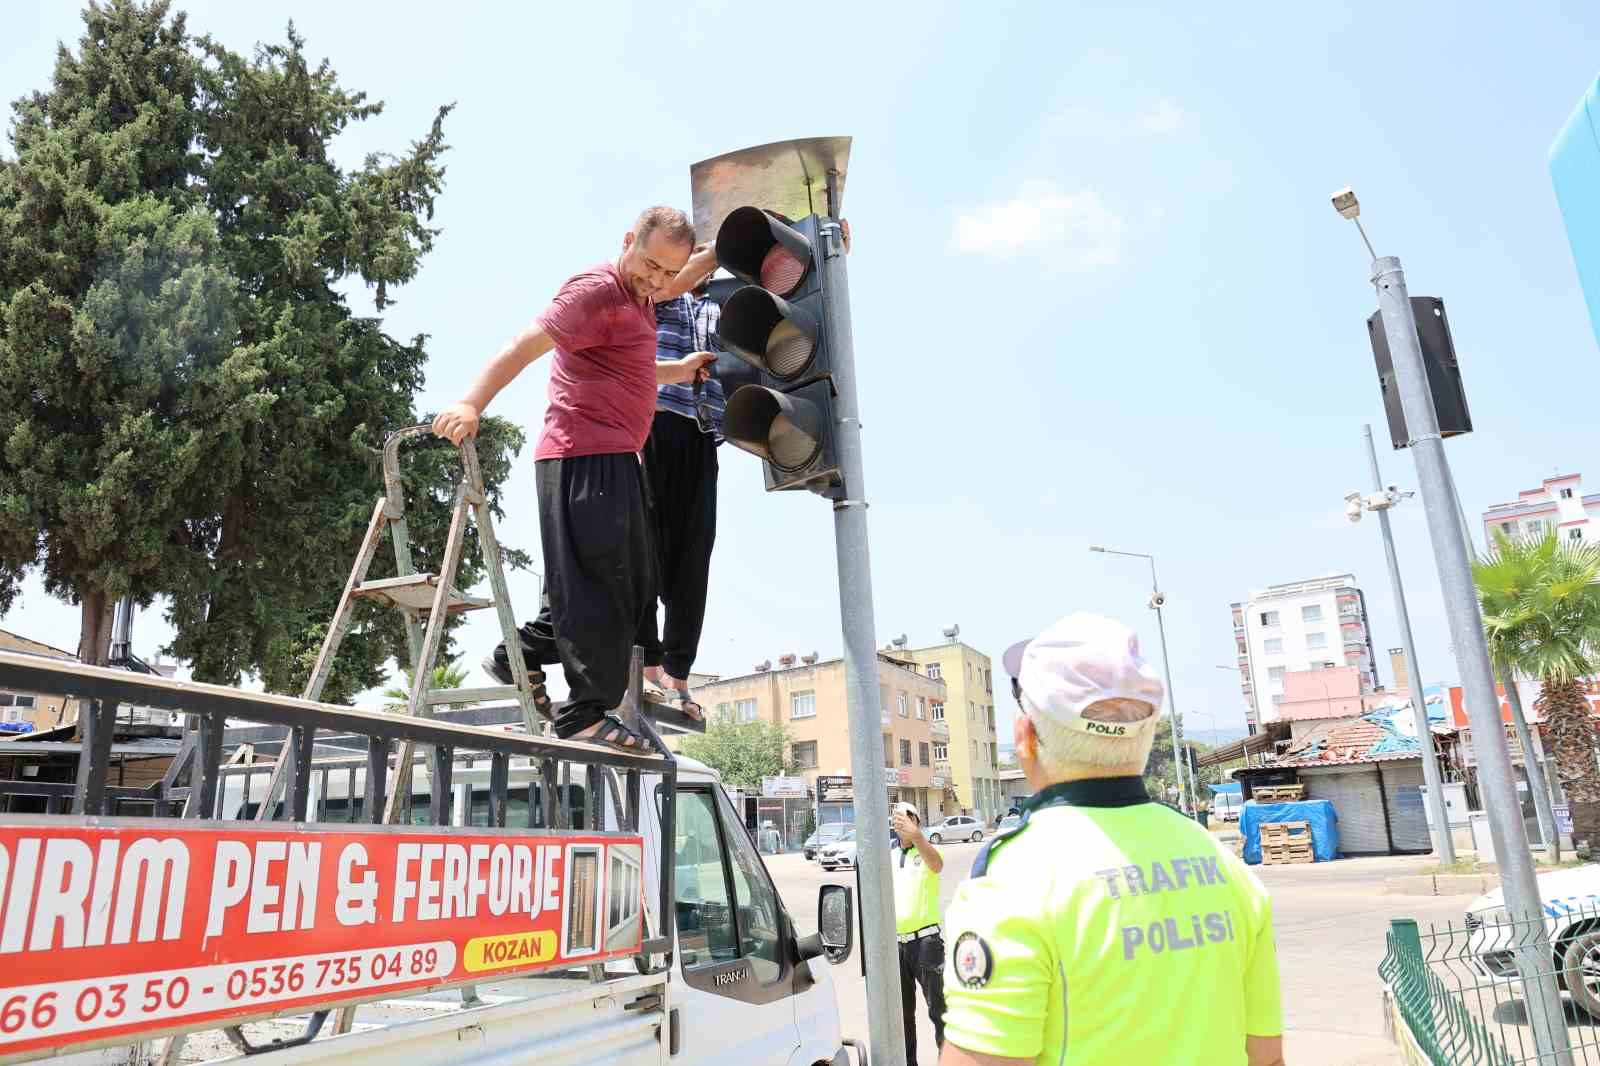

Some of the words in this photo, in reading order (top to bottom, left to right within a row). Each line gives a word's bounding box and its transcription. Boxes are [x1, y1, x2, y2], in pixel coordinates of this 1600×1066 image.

[0, 838, 190, 954] IRIM
[203, 840, 322, 948] PEN
[334, 842, 379, 926] &
[392, 843, 562, 923] FERFORJE
[1, 993, 57, 1034] 66
[75, 983, 128, 1022] 03
[142, 975, 190, 1013] 50
[227, 962, 304, 1000] 0536
[315, 956, 362, 989] 735
[371, 952, 402, 980] 04
[410, 948, 438, 975] 89
[482, 936, 542, 964] KOZAN
